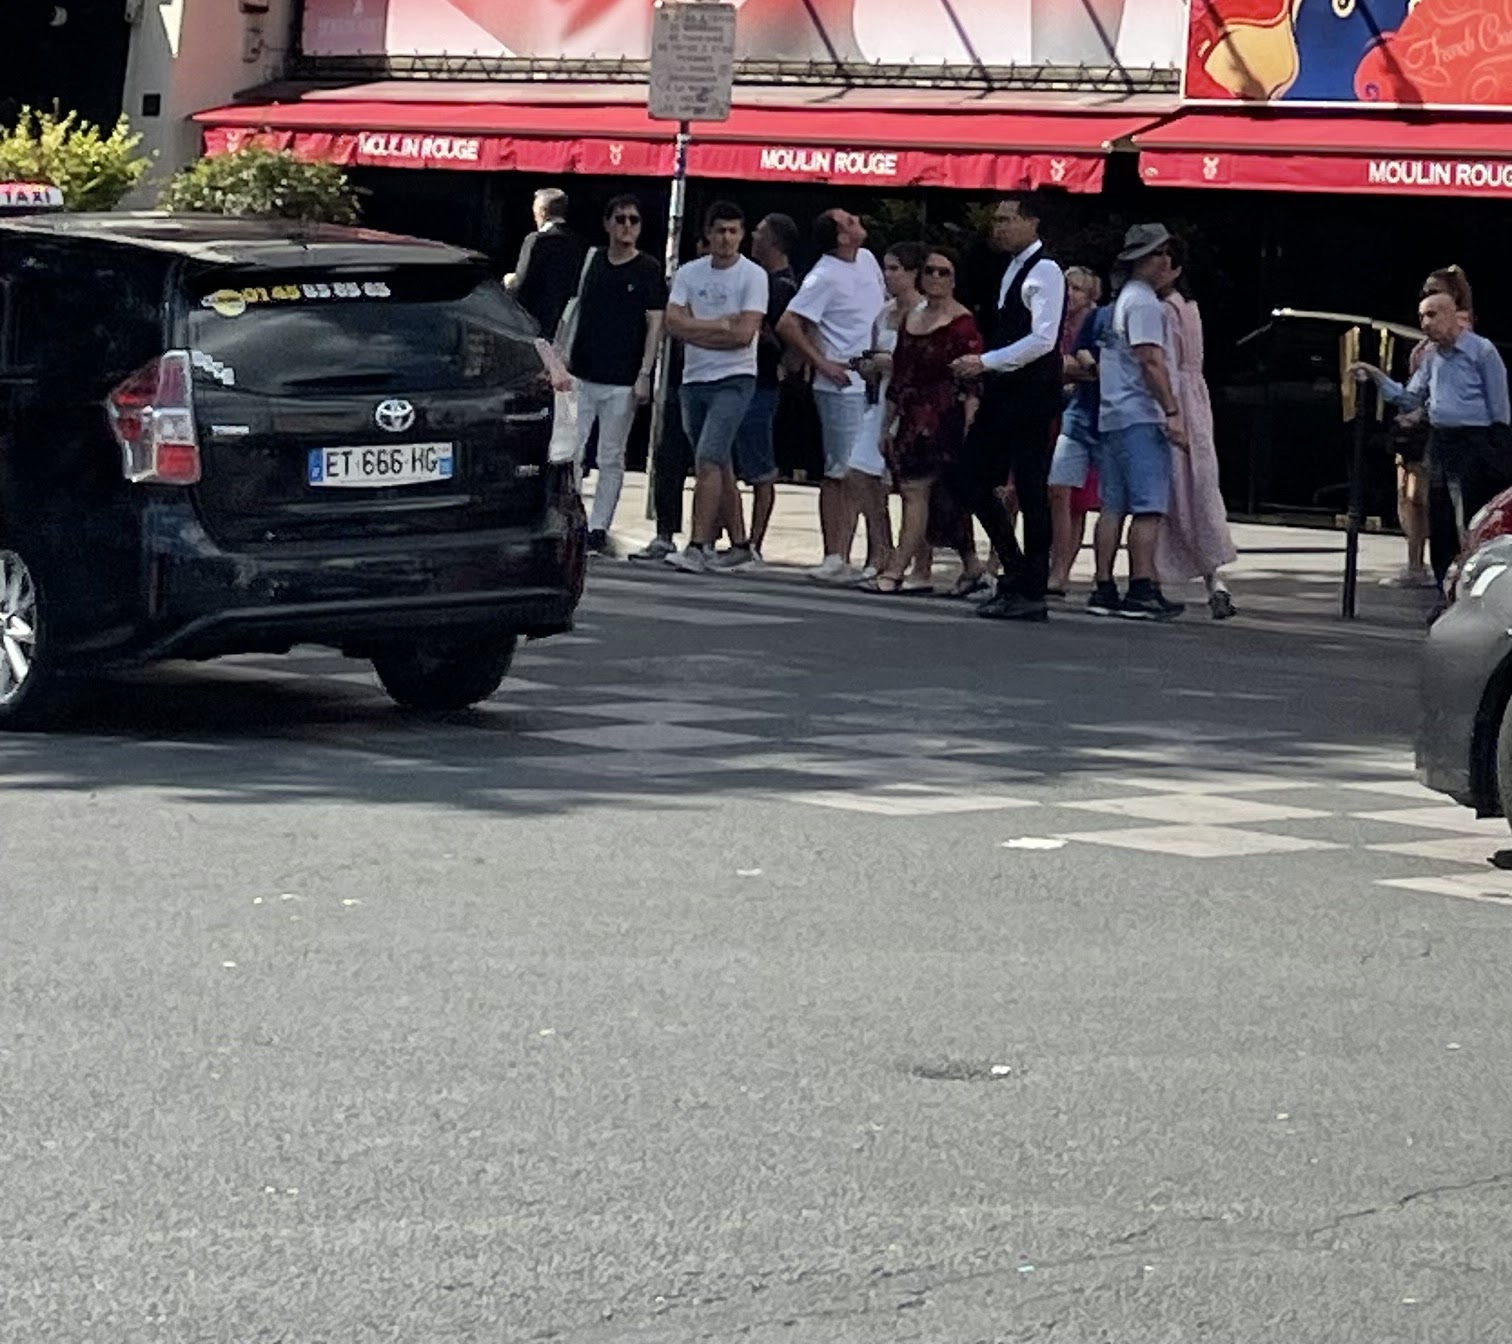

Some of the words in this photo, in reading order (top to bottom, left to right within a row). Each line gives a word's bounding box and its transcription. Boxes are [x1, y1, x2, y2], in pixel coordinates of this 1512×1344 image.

[420, 137, 480, 161] ROUGE
[760, 148, 831, 173] MOULIN
[834, 151, 897, 175] ROUGE
[1368, 160, 1451, 186] MOULIN
[5, 190, 51, 205] TAXI
[326, 451, 352, 478] ET
[362, 448, 403, 476] 666
